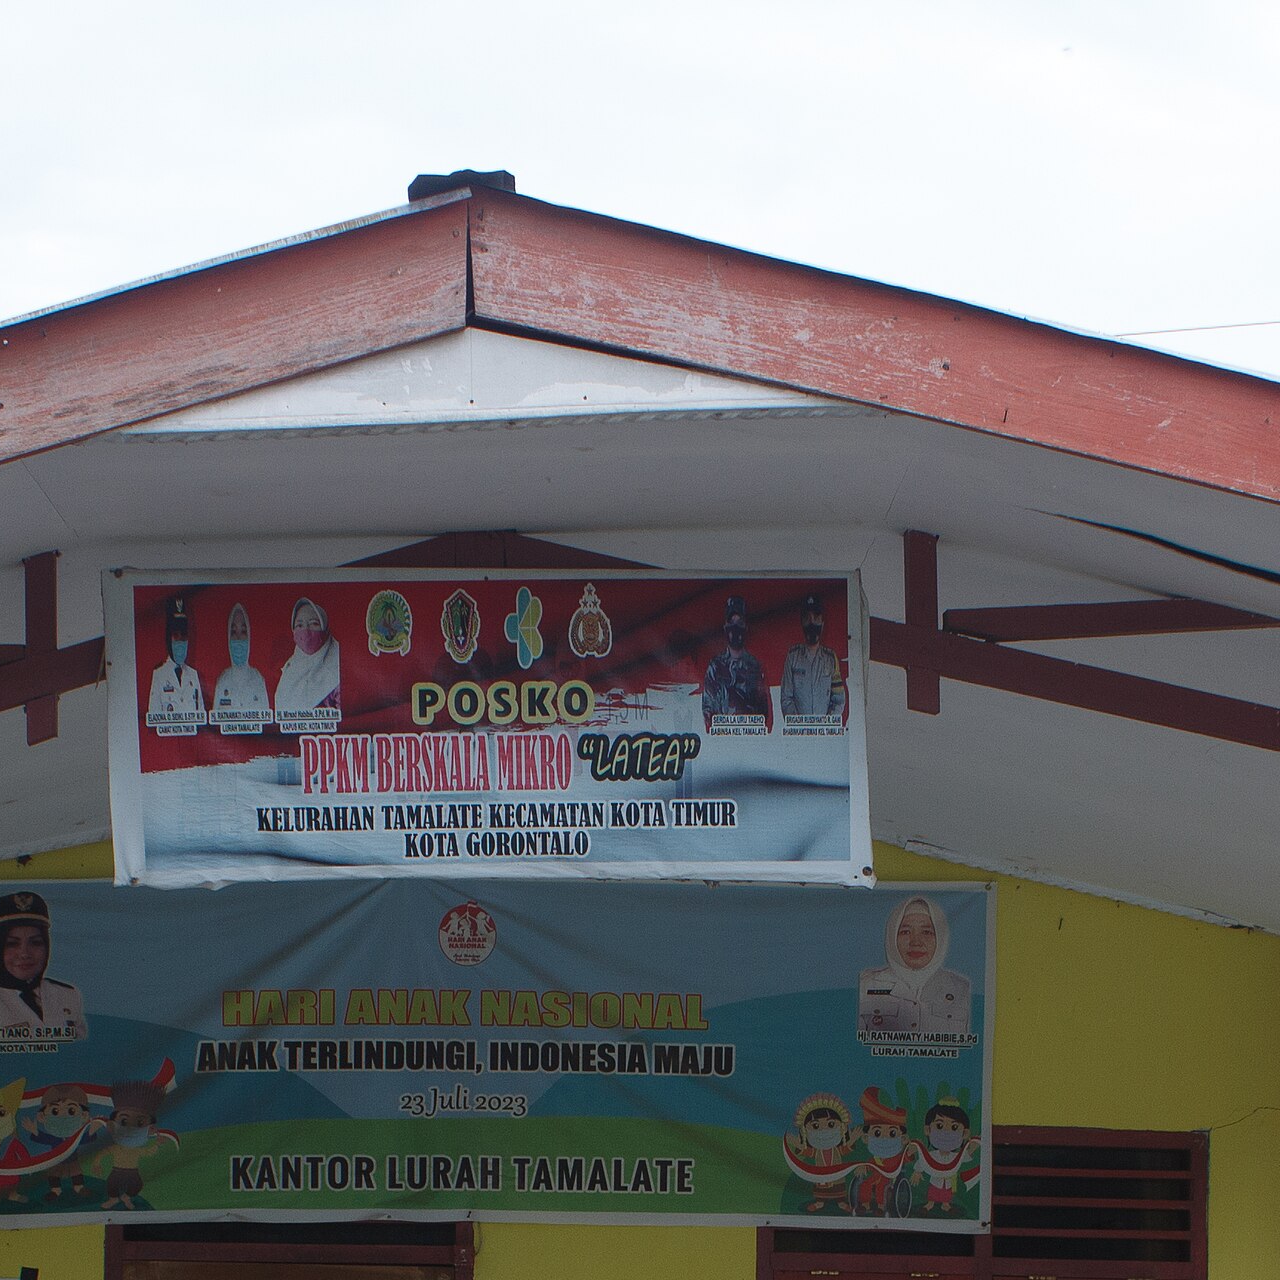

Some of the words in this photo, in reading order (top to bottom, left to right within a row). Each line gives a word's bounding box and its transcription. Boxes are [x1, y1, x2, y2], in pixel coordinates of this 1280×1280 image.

[415, 684, 591, 721] POSKO
[303, 737, 370, 795] PPKM
[373, 737, 491, 793] BERSKALA
[497, 736, 571, 791] MIKRO
[257, 805, 375, 833] KELURAHAN
[380, 803, 483, 830] TAMALATE
[488, 802, 605, 828] KECAMATAN
[609, 802, 666, 828] KOTA
[670, 802, 736, 828] TIMUR
[404, 832, 460, 858] KOTA
[466, 831, 589, 857] GORONTALO
[222, 989, 336, 1026] HARI
[344, 989, 472, 1026] ANAK
[480, 989, 709, 1031] NASIONAL
[0, 1044, 25, 1053] KOTA
[28, 1044, 57, 1052] TIMUR
[8, 1028, 32, 1039] ANO,
[858, 1031, 869, 1042] Hj.
[871, 1032, 922, 1042] RATNAWATY
[196, 1040, 278, 1072] ANAK
[285, 1039, 483, 1075] TERLINDUNGI,
[489, 1041, 652, 1073] INDONESIA
[655, 1043, 734, 1075] MAJU
[873, 1048, 905, 1056] LURAH
[908, 1048, 958, 1058] TAMALATE
[400, 1093, 425, 1114] 23
[425, 1085, 472, 1116] Juli
[474, 1094, 527, 1116] 2023
[231, 1155, 375, 1190] KANTOR
[386, 1155, 501, 1191] LURAH
[512, 1157, 695, 1193] TAMALATE
